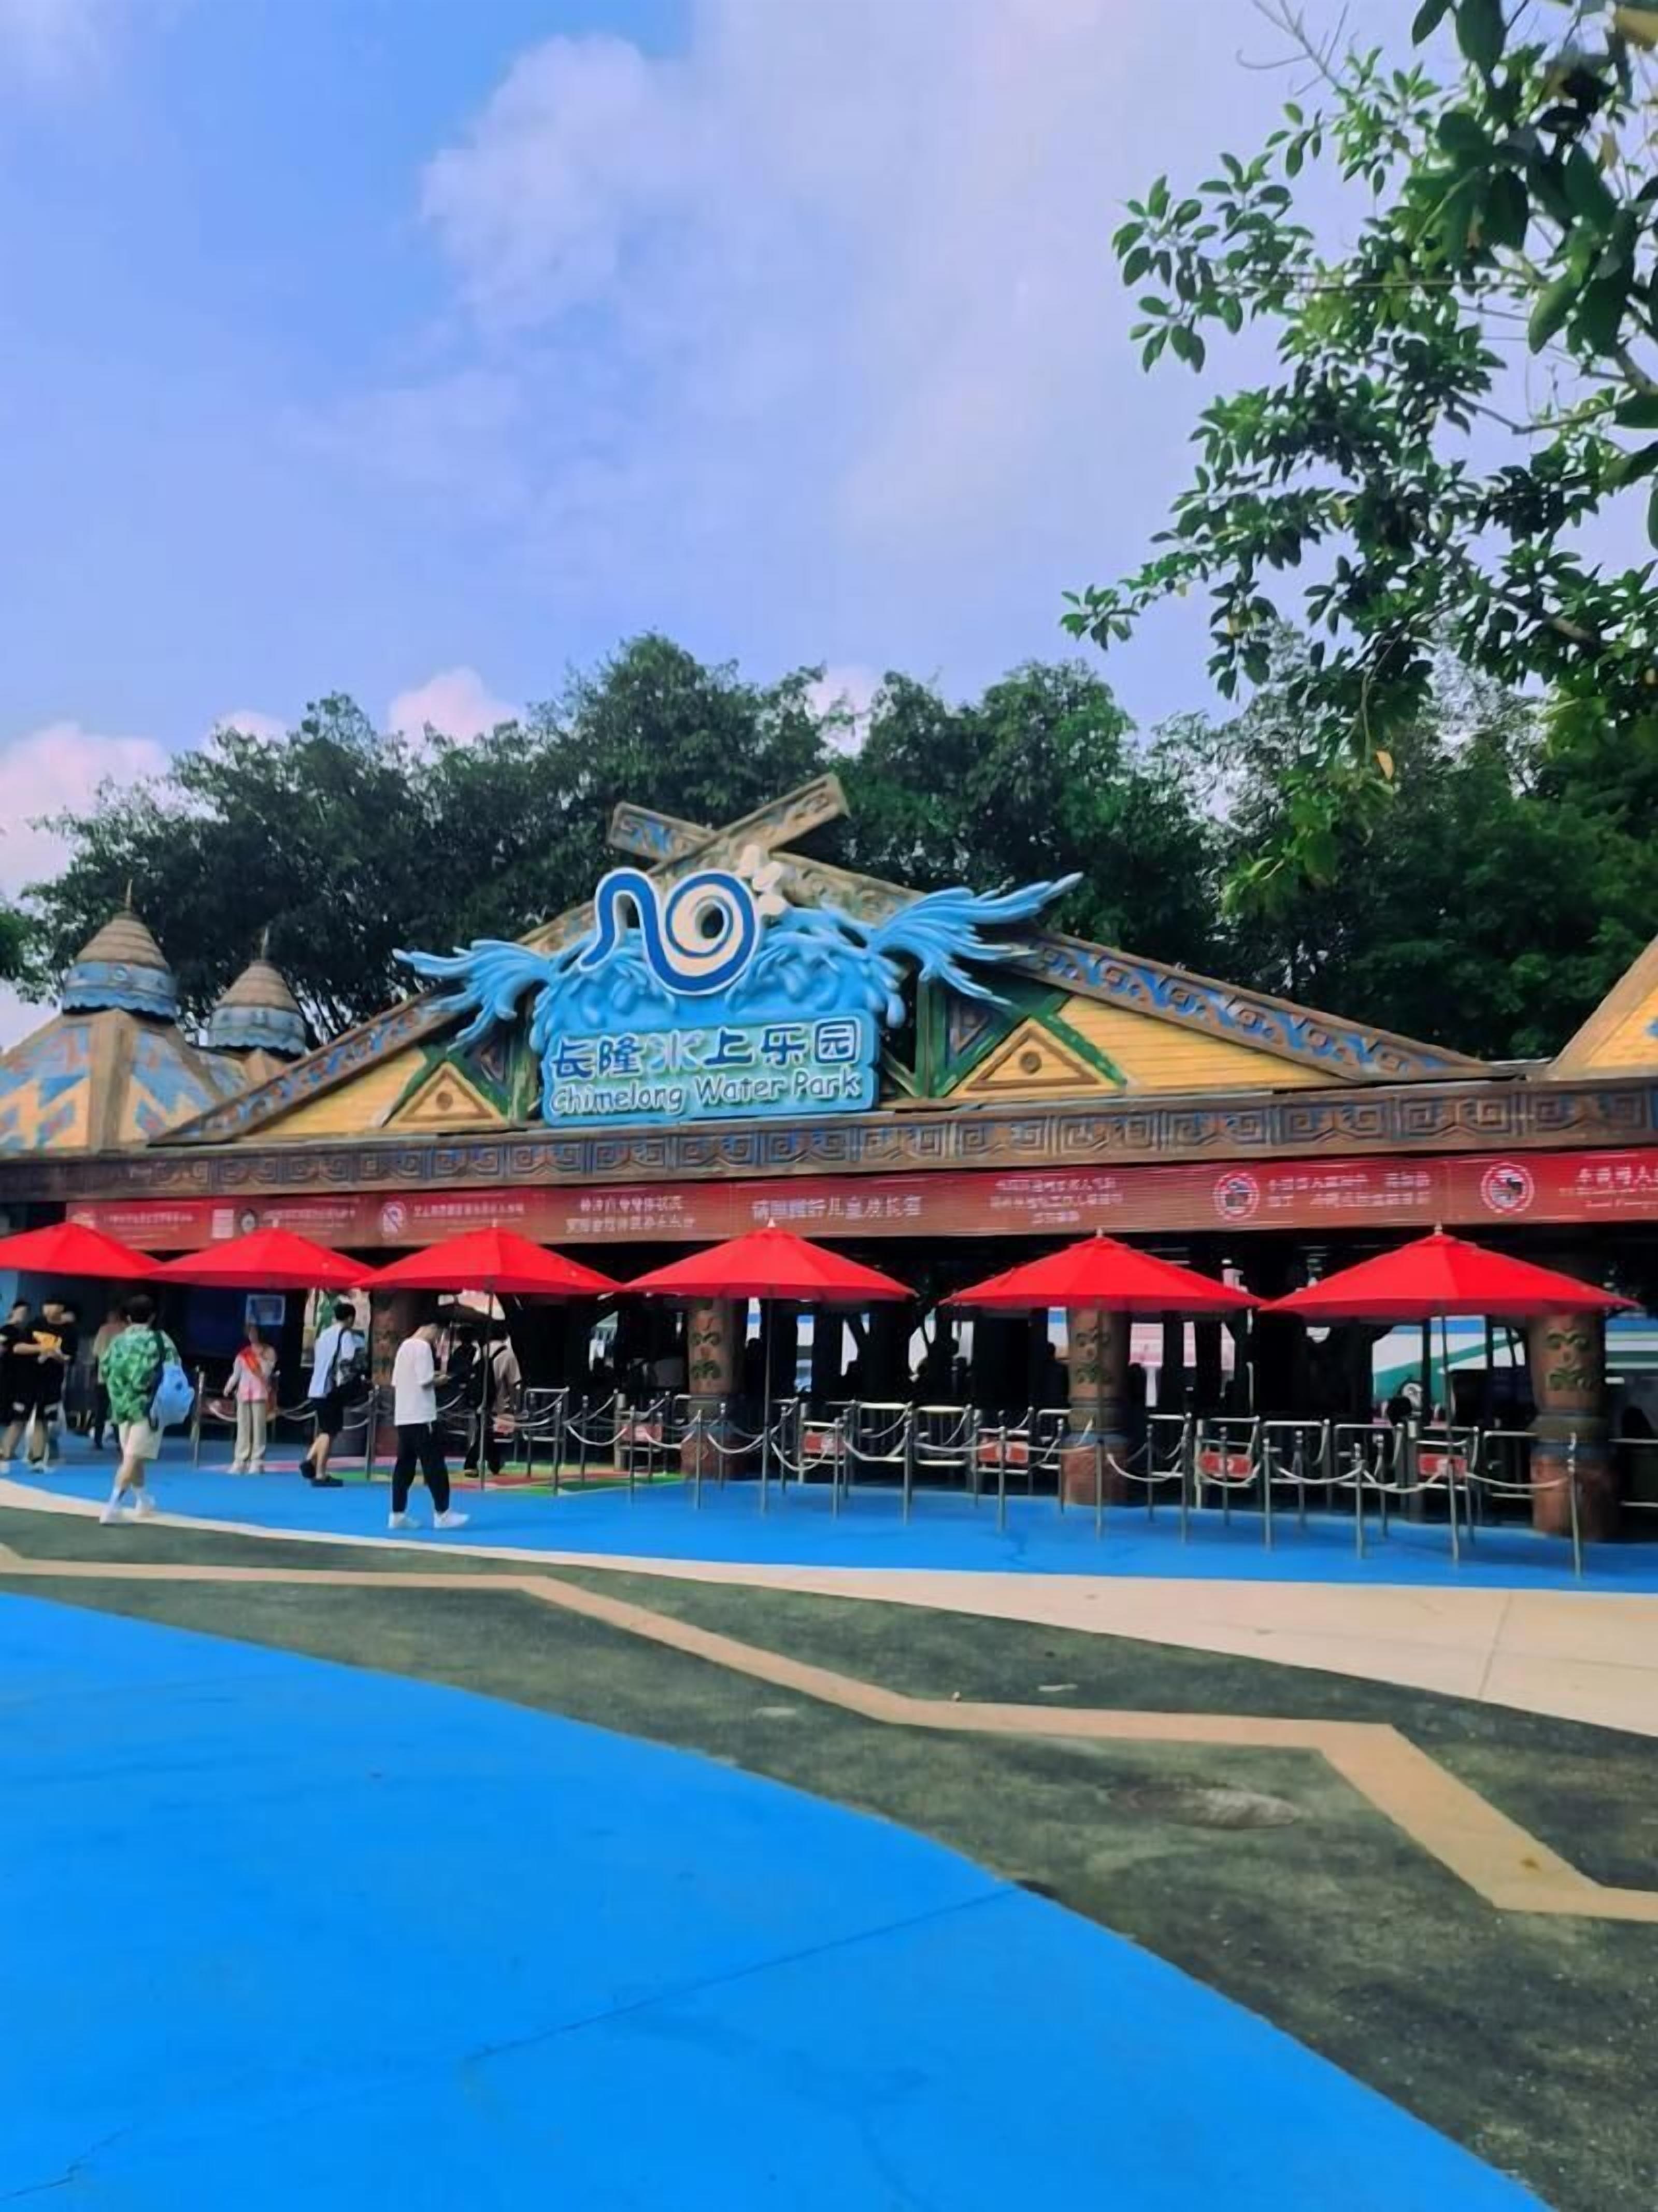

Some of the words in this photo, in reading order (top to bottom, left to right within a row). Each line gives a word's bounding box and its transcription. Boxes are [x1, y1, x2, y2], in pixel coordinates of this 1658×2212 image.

[552, 1018, 860, 1079] 长隆水上乐园
[551, 1081, 683, 1114] Chimelong
[695, 1074, 787, 1105] Water
[792, 1064, 862, 1100] Park
